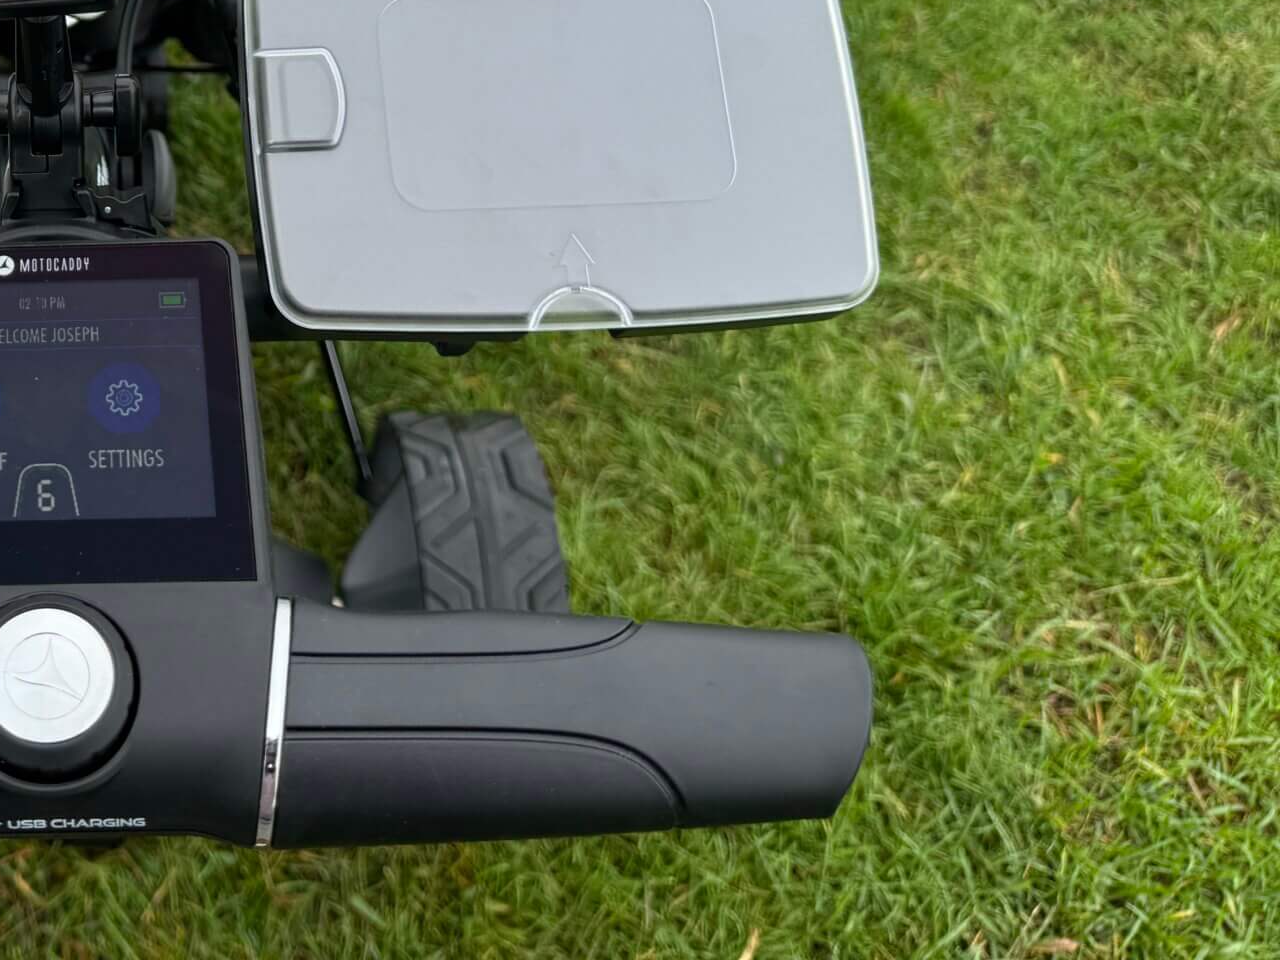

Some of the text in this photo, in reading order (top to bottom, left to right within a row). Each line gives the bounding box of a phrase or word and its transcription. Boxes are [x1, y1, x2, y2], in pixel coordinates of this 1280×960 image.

[19, 256, 91, 273] MOTOCADDY
[49, 295, 66, 310] PM
[51, 326, 100, 343] JOSEPH
[87, 449, 165, 470] SETTINGS
[36, 479, 56, 512] 6
[7, 817, 147, 830] USB CHARGING
